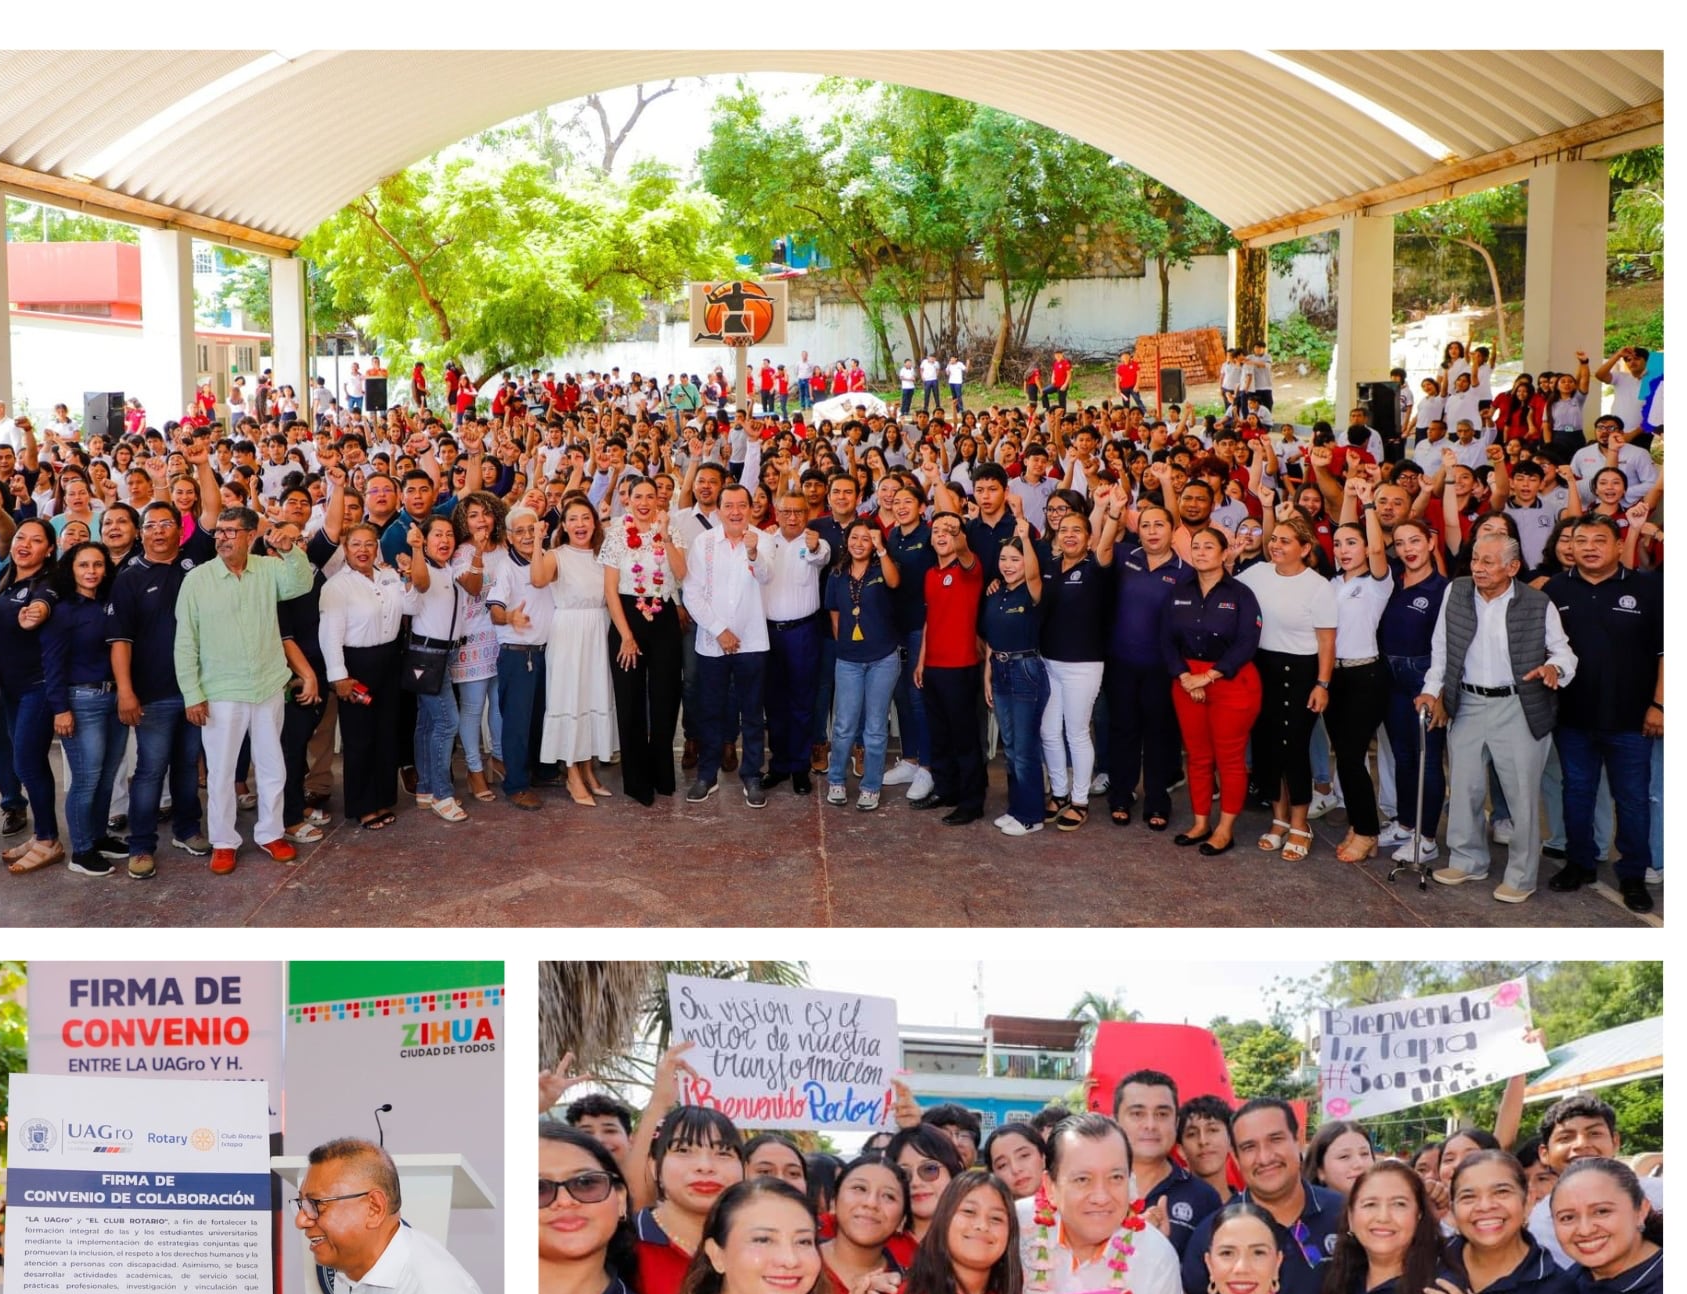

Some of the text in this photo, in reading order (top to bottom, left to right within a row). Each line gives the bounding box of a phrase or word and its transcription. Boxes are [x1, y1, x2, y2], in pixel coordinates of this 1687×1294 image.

[70, 976, 241, 1007] FIRMA DE
[680, 986, 712, 1020] Su
[839, 998, 861, 1028] el
[62, 1016, 249, 1048] CONVENIO
[401, 1018, 495, 1047] ZIHUA
[400, 1043, 495, 1058] CIUDAD DE TODOS
[681, 1023, 880, 1061] motor de nuestra
[69, 1056, 243, 1072] ENTRE LA UAGro Y H.
[68, 1123, 133, 1140] UAGro
[147, 1133, 188, 1146] Rotary
[102, 1175, 175, 1186] FIRMA DE
[24, 1190, 255, 1205] CONVENIO DE COLABORACIÓN
